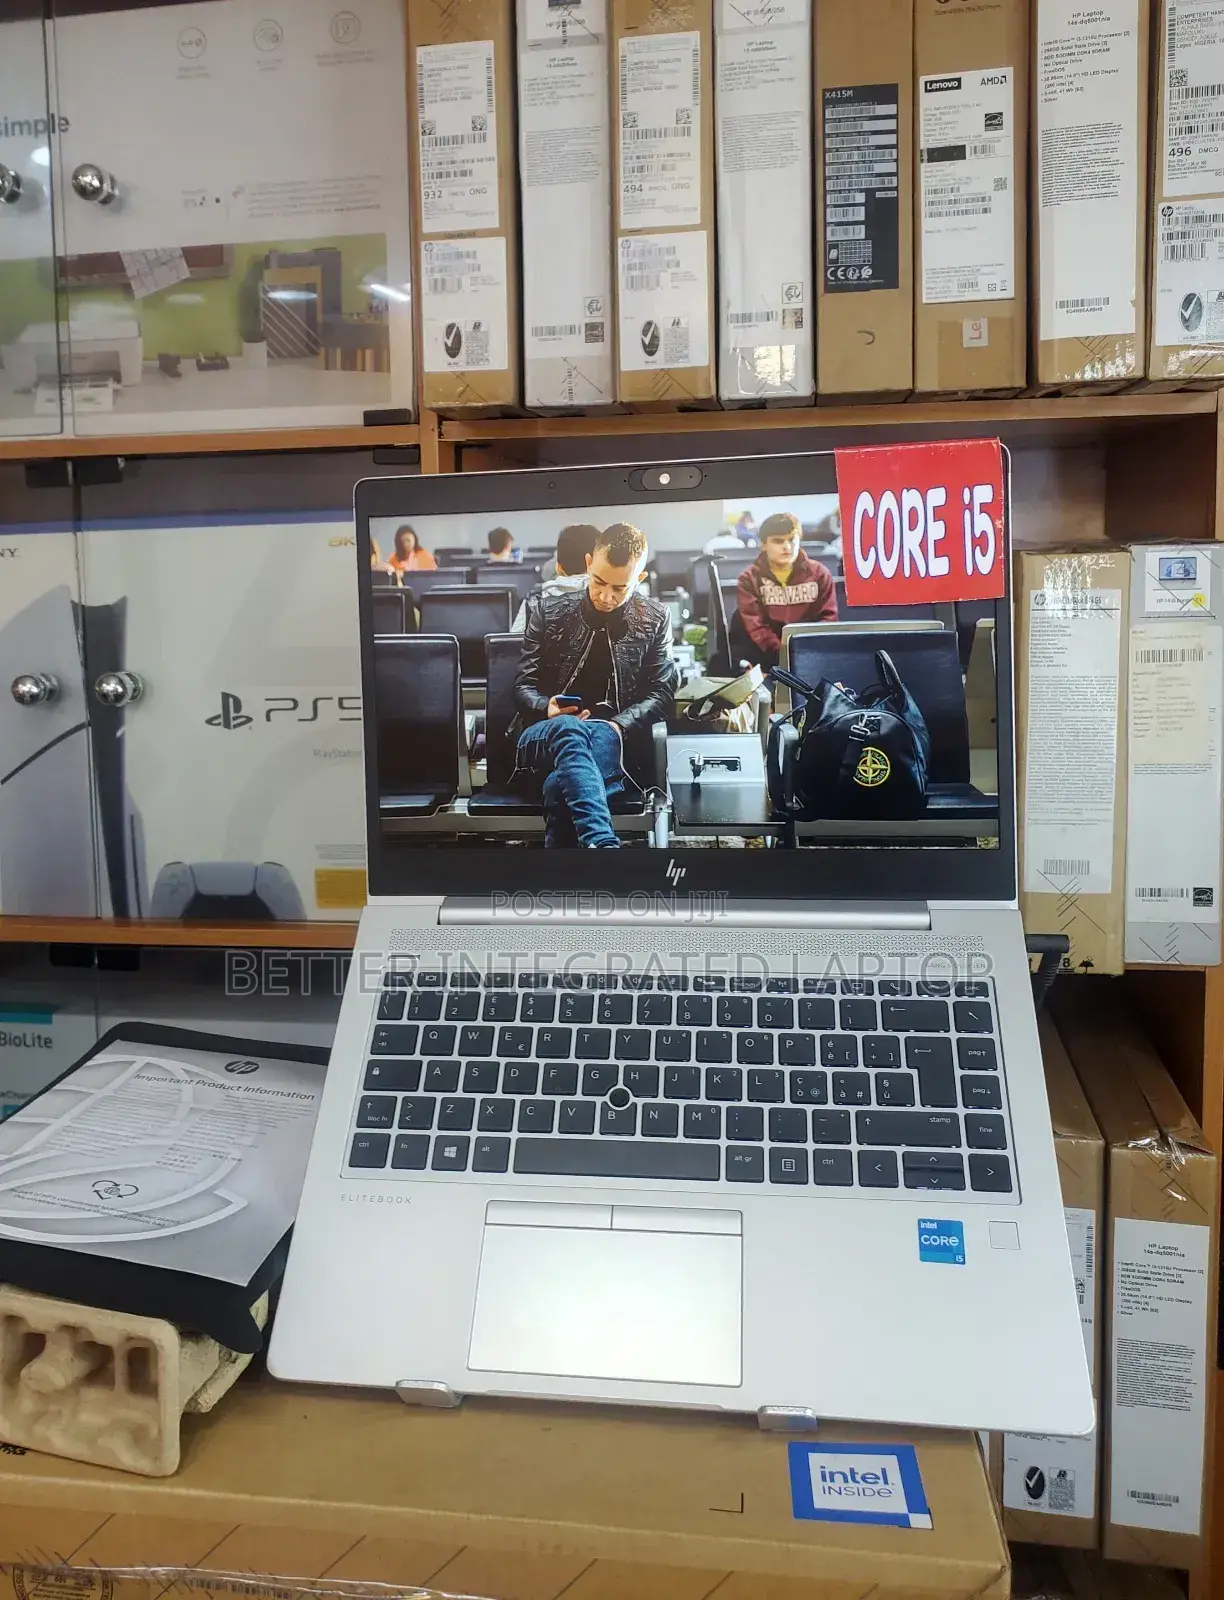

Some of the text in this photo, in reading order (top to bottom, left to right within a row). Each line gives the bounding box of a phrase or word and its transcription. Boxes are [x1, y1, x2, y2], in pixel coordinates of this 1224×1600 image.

[1082, 10, 1104, 18] Laptop
[1177, 11, 1209, 20] COMPETENT
[1177, 16, 1214, 26] ENTERPRISES
[926, 80, 958, 90] Lenovo
[980, 77, 1000, 86] AMD
[824, 90, 854, 99] X415M
[1168, 146, 1219, 157] 496 DMCQ
[424, 190, 443, 200] 932
[469, 187, 488, 195] ONG
[623, 184, 644, 194] 494
[853, 484, 996, 579] CORE i5
[666, 858, 686, 886] hp
[528, 997, 534, 1005] $
[566, 998, 575, 1006] %
[451, 1007, 458, 1015] 2
[604, 1010, 611, 1018] 6
[644, 1010, 650, 1019] 7
[684, 1012, 691, 1020] 8
[724, 1013, 732, 1021] 9
[0, 1030, 53, 1049] BioLite
[429, 1031, 439, 1040] Q
[467, 1031, 480, 1040] W
[505, 1032, 513, 1041] E
[544, 1033, 552, 1042] R
[582, 1034, 590, 1042] T
[622, 1034, 632, 1043] Y
[663, 1036, 672, 1045] U
[745, 1038, 755, 1047] O
[786, 1040, 794, 1049] P
[224, 1060, 260, 1074] hp
[433, 1067, 442, 1076] A
[472, 1068, 479, 1076] S
[510, 1068, 519, 1077] D
[549, 1069, 558, 1078] F
[590, 1070, 600, 1079] G
[630, 1072, 640, 1080] H
[671, 1073, 679, 1082] J
[713, 1075, 722, 1084] K
[755, 1076, 763, 1085] L
[134, 1073, 315, 1100] Important Product Information
[446, 1105, 454, 1113] Z
[486, 1105, 495, 1114] X
[527, 1107, 535, 1116] C
[568, 1108, 576, 1116] V
[608, 1111, 616, 1120] B
[650, 1111, 659, 1120] N
[692, 1112, 702, 1121] M
[929, 1116, 951, 1125] stamp
[341, 1194, 413, 1204] ELITEBOOK
[920, 1221, 938, 1229] intel
[820, 1465, 894, 1486] intel
